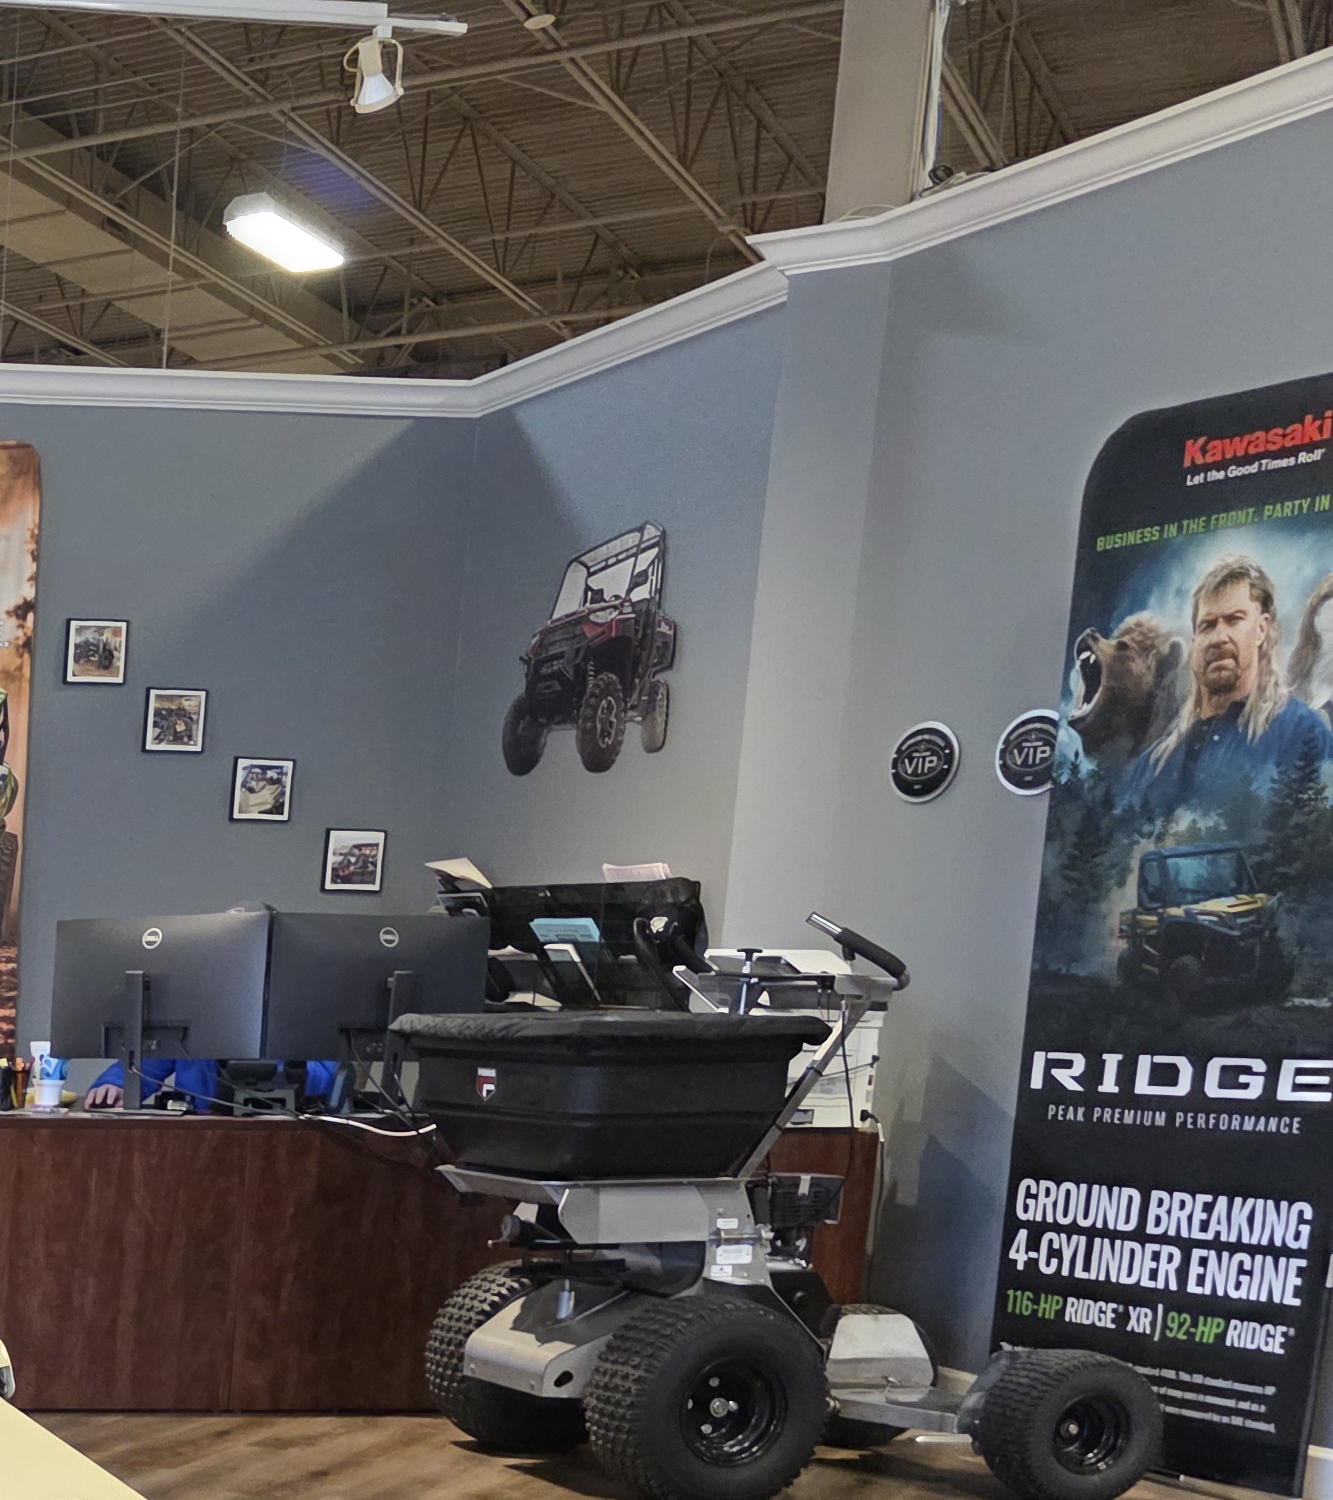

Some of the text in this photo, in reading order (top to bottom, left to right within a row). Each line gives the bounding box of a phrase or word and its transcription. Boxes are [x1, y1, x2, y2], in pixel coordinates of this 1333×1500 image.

[1183, 409, 1333, 468] Kawasaki
[1186, 474, 1204, 486] Let
[1207, 469, 1225, 481] the
[1227, 461, 1259, 478] Good
[1260, 456, 1296, 471] Times
[1096, 493, 1332, 552] BUSINESS IN THE FRONT. PARTY IN
[903, 755, 938, 774] VIP
[1013, 746, 1051, 765] VIP
[1030, 1051, 1333, 1102] RIDGE
[1047, 1104, 1302, 1135] PEAK PREMIUM PERFORMANCE
[1015, 1177, 1314, 1250] GROUND BREAKING
[1008, 1228, 1182, 1291] 4-CYLINDER
[1186, 1248, 1308, 1307] ENGINE
[1006, 1289, 1064, 1320] 116-HP
[1165, 1311, 1225, 1344] 92-HP
